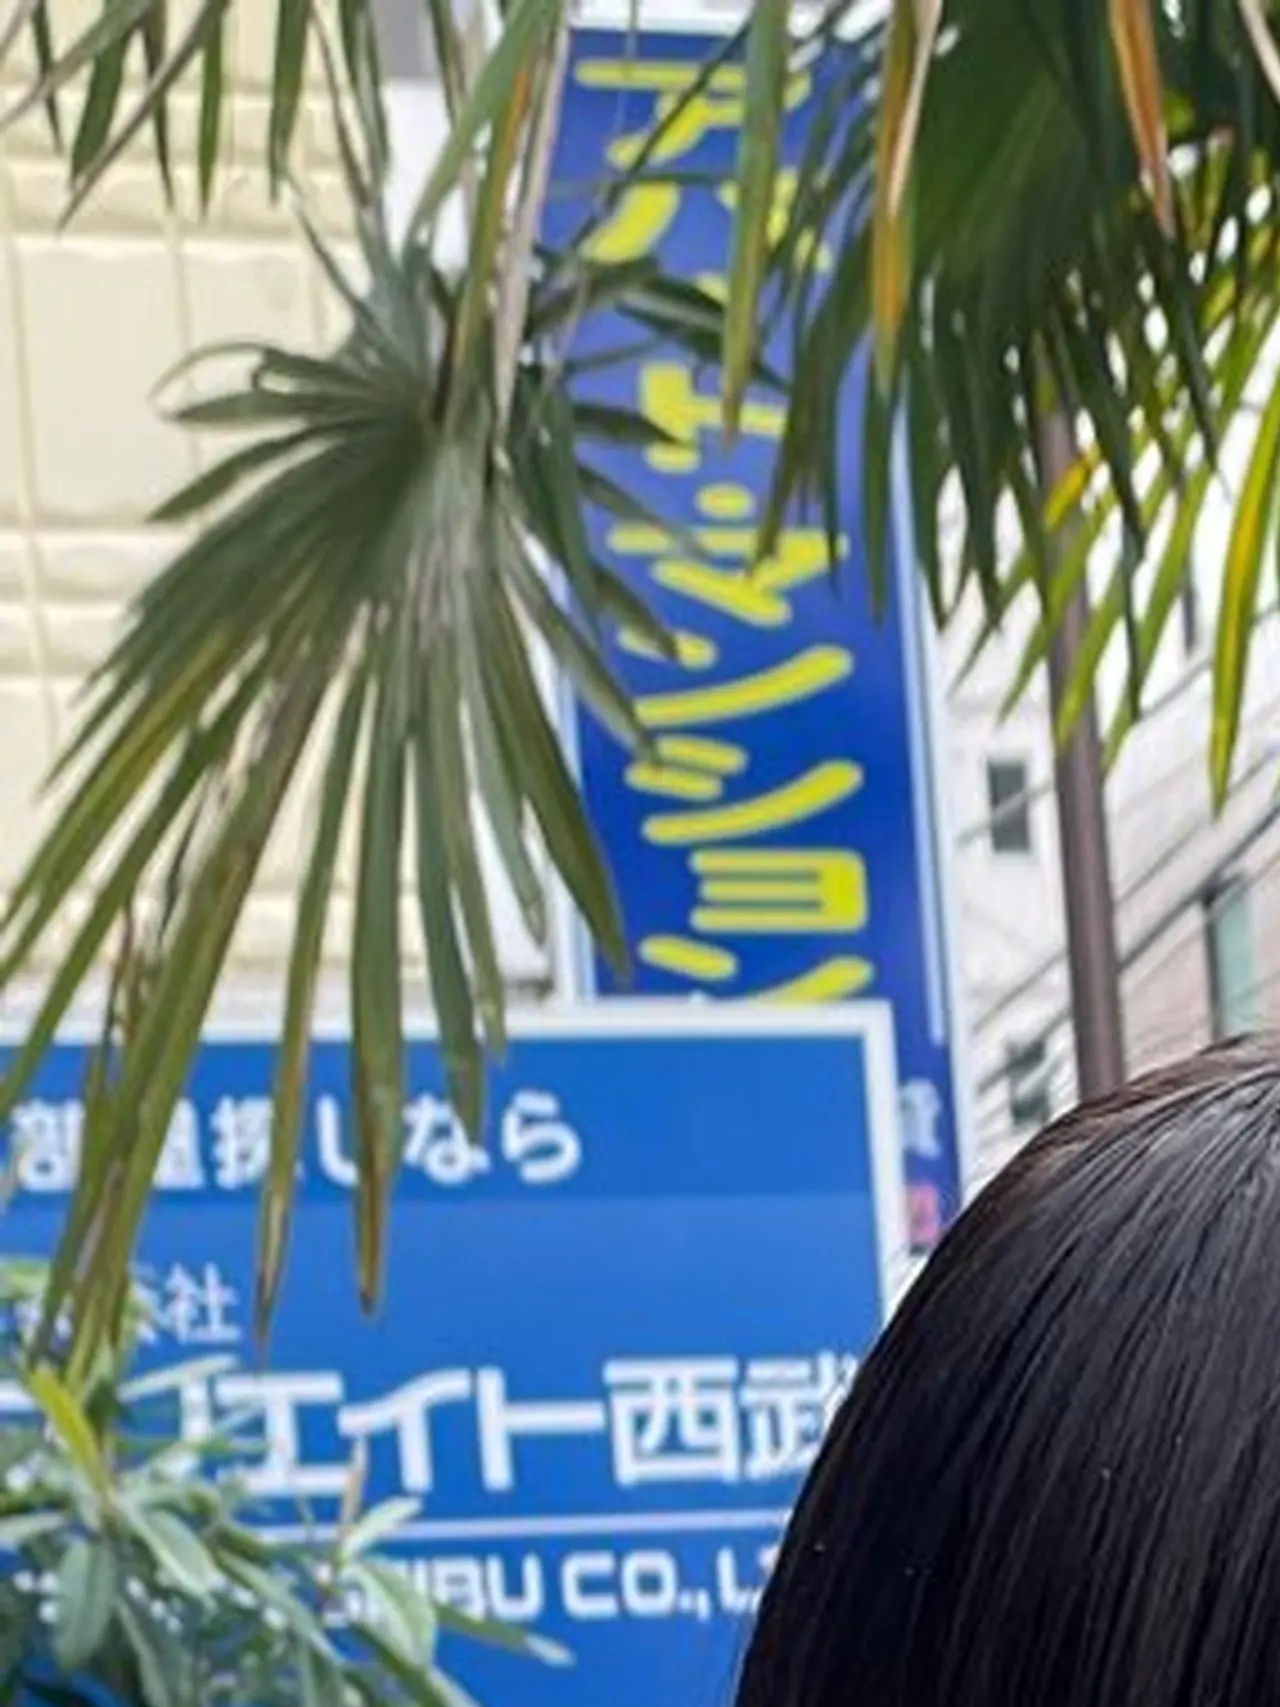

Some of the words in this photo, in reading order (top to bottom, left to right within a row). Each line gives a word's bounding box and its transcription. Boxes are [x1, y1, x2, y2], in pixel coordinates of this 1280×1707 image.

[573, 58, 874, 1000] アパト・マンション
